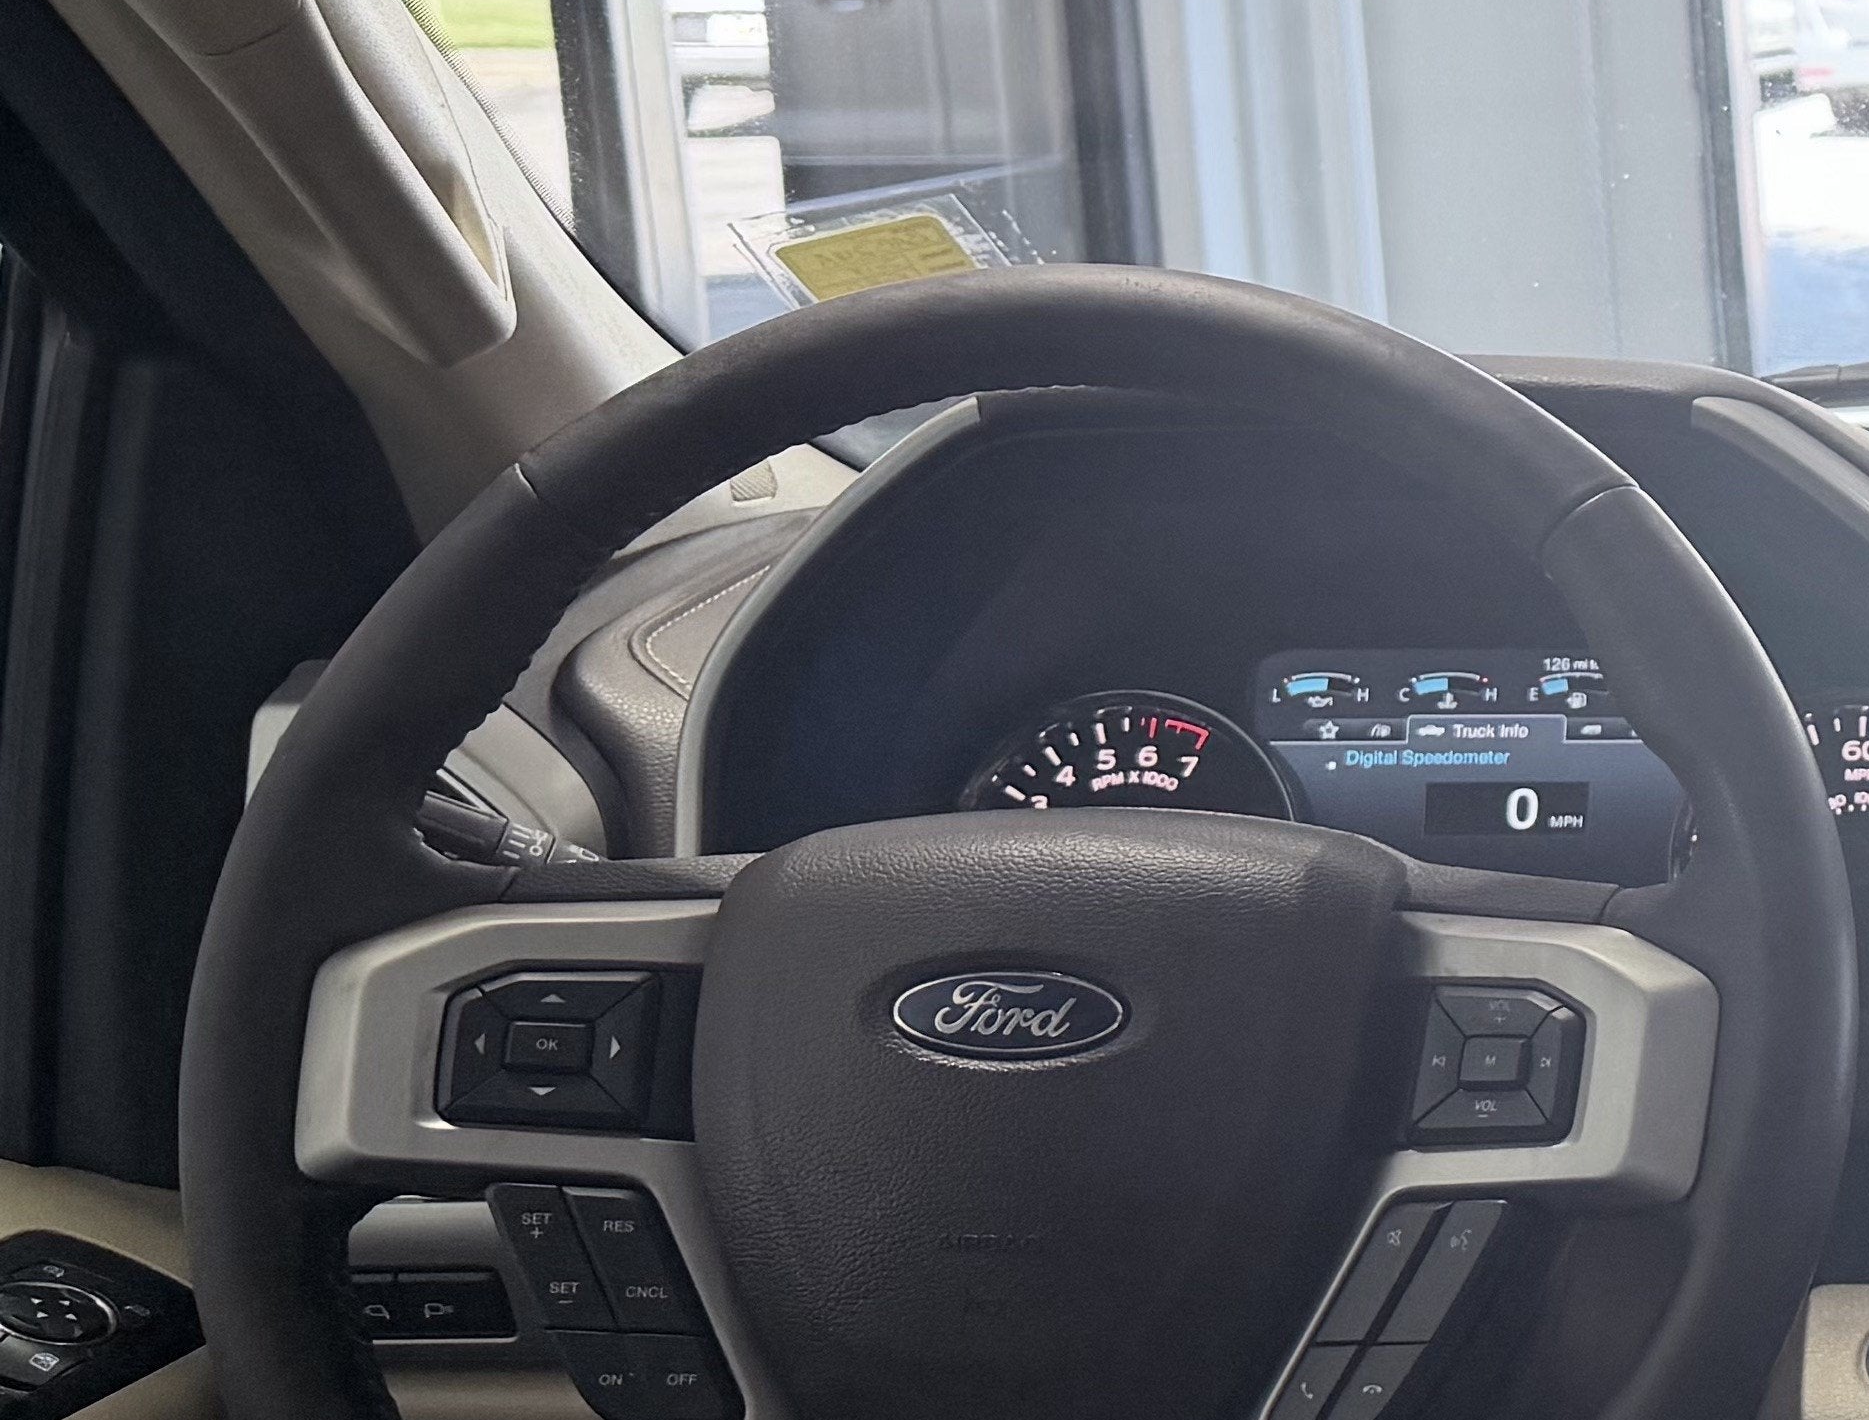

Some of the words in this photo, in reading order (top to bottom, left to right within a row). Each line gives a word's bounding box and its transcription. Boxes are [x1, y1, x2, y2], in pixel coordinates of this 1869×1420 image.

[1543, 657, 1571, 672] 126
[1272, 688, 1281, 703] L
[1356, 688, 1370, 702] H
[1399, 688, 1411, 702] C
[1484, 687, 1497, 702] H
[1529, 687, 1539, 701] E
[1453, 723, 1495, 738] Truck
[1500, 723, 1529, 738] Info
[1096, 749, 1116, 770] 5
[1137, 746, 1158, 767] 6
[1346, 750, 1398, 768] Digital
[1402, 750, 1511, 768] Speedometer
[1178, 756, 1199, 777] 7
[1056, 766, 1076, 787] 4
[1090, 771, 1125, 792] RPM
[1142, 770, 1179, 792] 1000
[1506, 787, 1540, 830] 0
[1549, 815, 1585, 829] MPH
[934, 980, 1077, 1038] Ford
[535, 1038, 559, 1051] OK
[1474, 1100, 1498, 1112] VOL
[521, 1212, 552, 1226] SET
[603, 1220, 634, 1233] RES
[549, 1282, 579, 1295] SET
[625, 1286, 668, 1299] CNCL
[598, 1373, 623, 1386] ON
[666, 1373, 698, 1386] OFF
